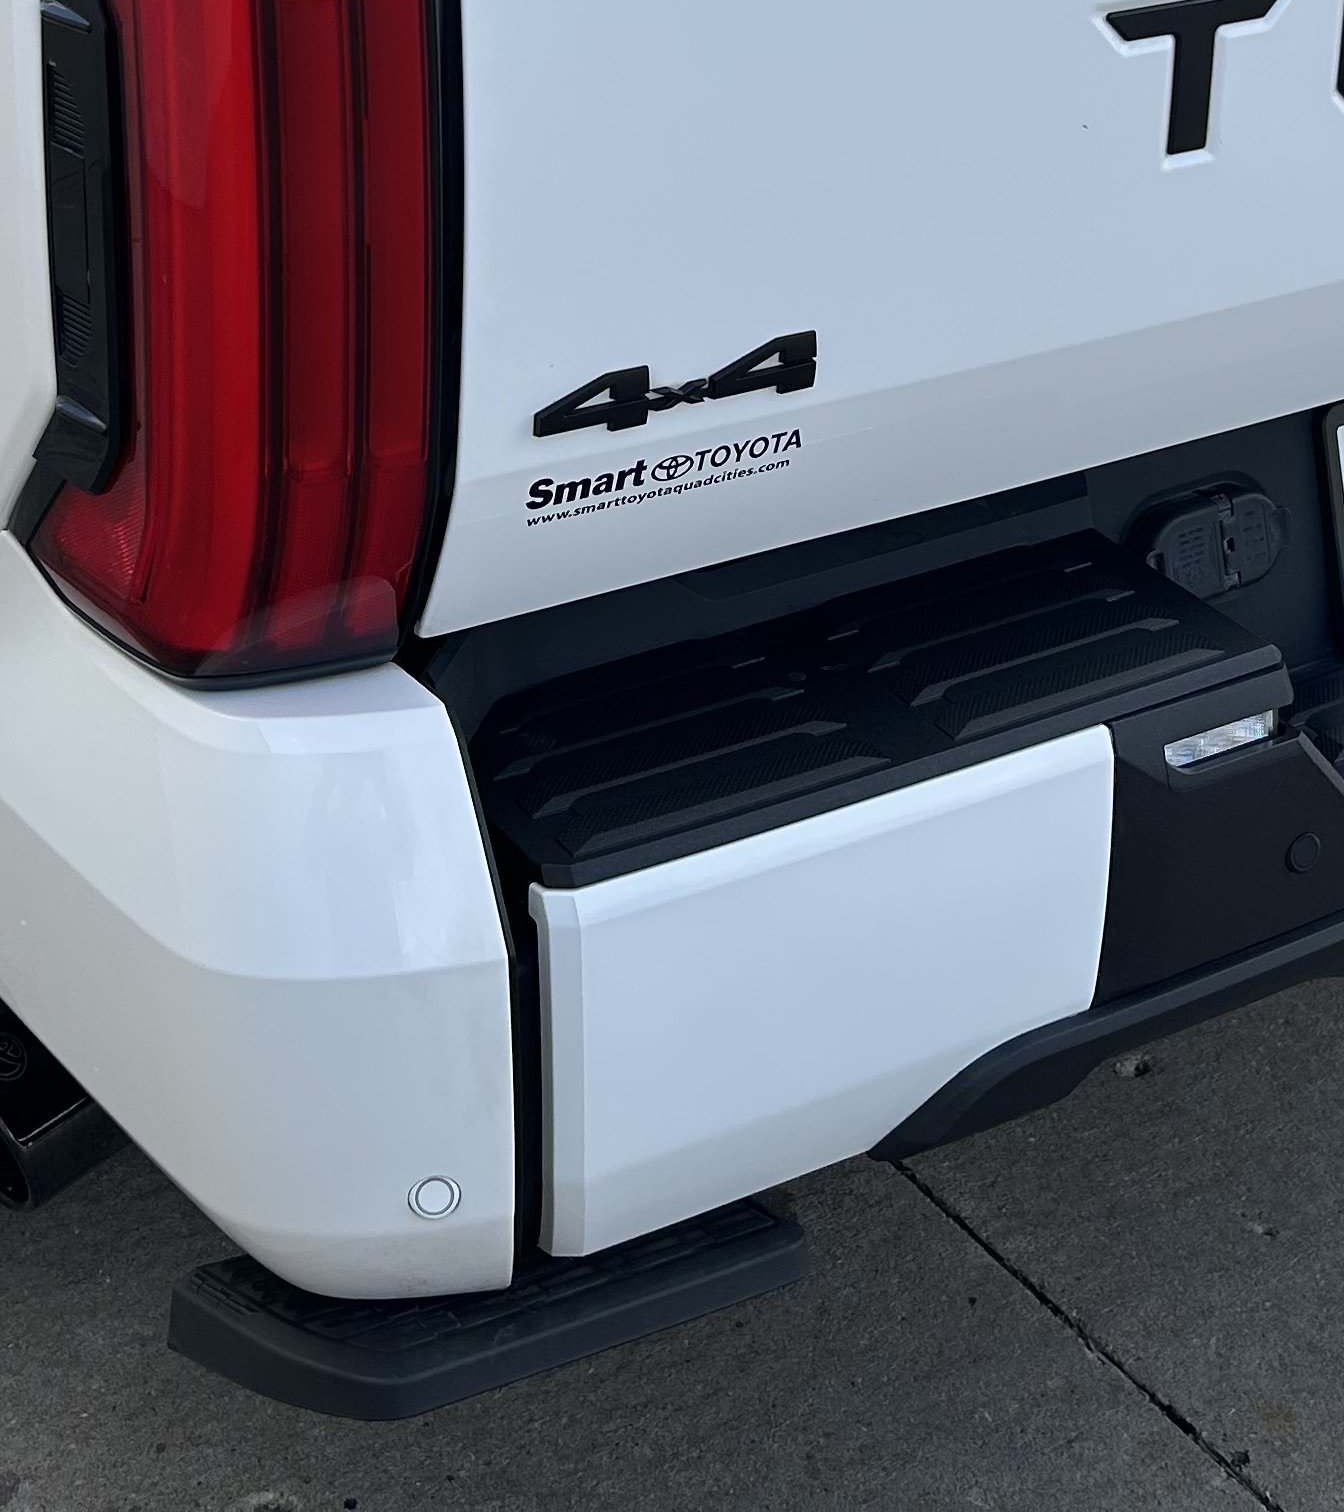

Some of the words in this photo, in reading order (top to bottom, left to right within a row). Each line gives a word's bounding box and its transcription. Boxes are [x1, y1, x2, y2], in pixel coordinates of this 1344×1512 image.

[525, 458, 648, 510] Smart
[694, 429, 803, 472] TOYOTA
[526, 458, 790, 527] www.smarttoyotaquadcities.com
